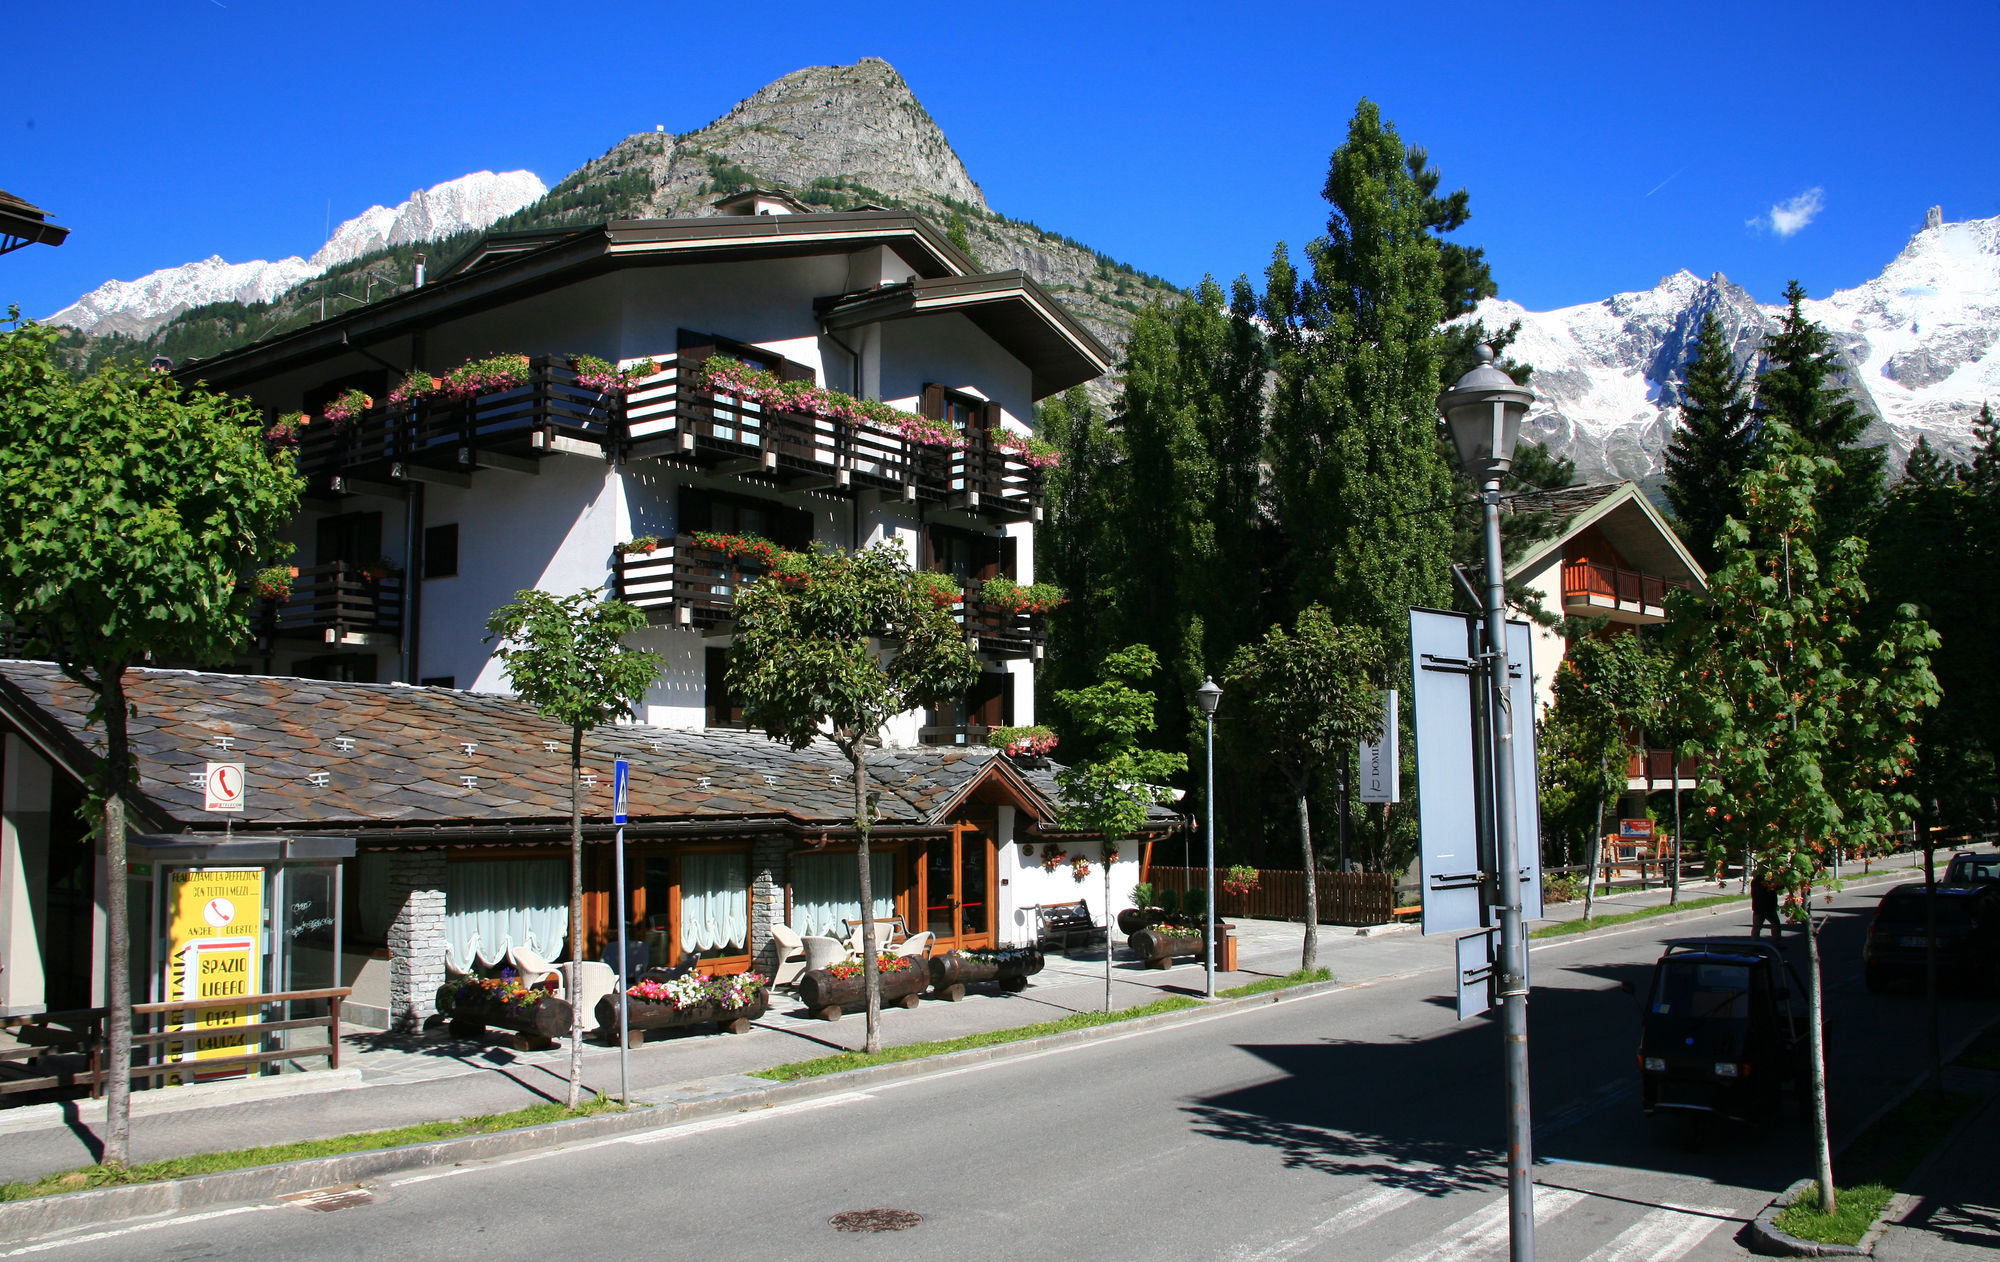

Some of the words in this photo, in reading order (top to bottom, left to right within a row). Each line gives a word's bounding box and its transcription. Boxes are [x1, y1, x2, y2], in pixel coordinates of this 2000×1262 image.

[215, 872, 223, 881] LA
[224, 871, 259, 881] PERFEZIONE
[193, 887, 205, 897] CON
[207, 886, 225, 897] TUTTI
[187, 926, 212, 936] ANCHE
[202, 957, 247, 975] SPAZIO
[202, 980, 245, 997] LIBERO
[206, 1010, 236, 1026] 0121
